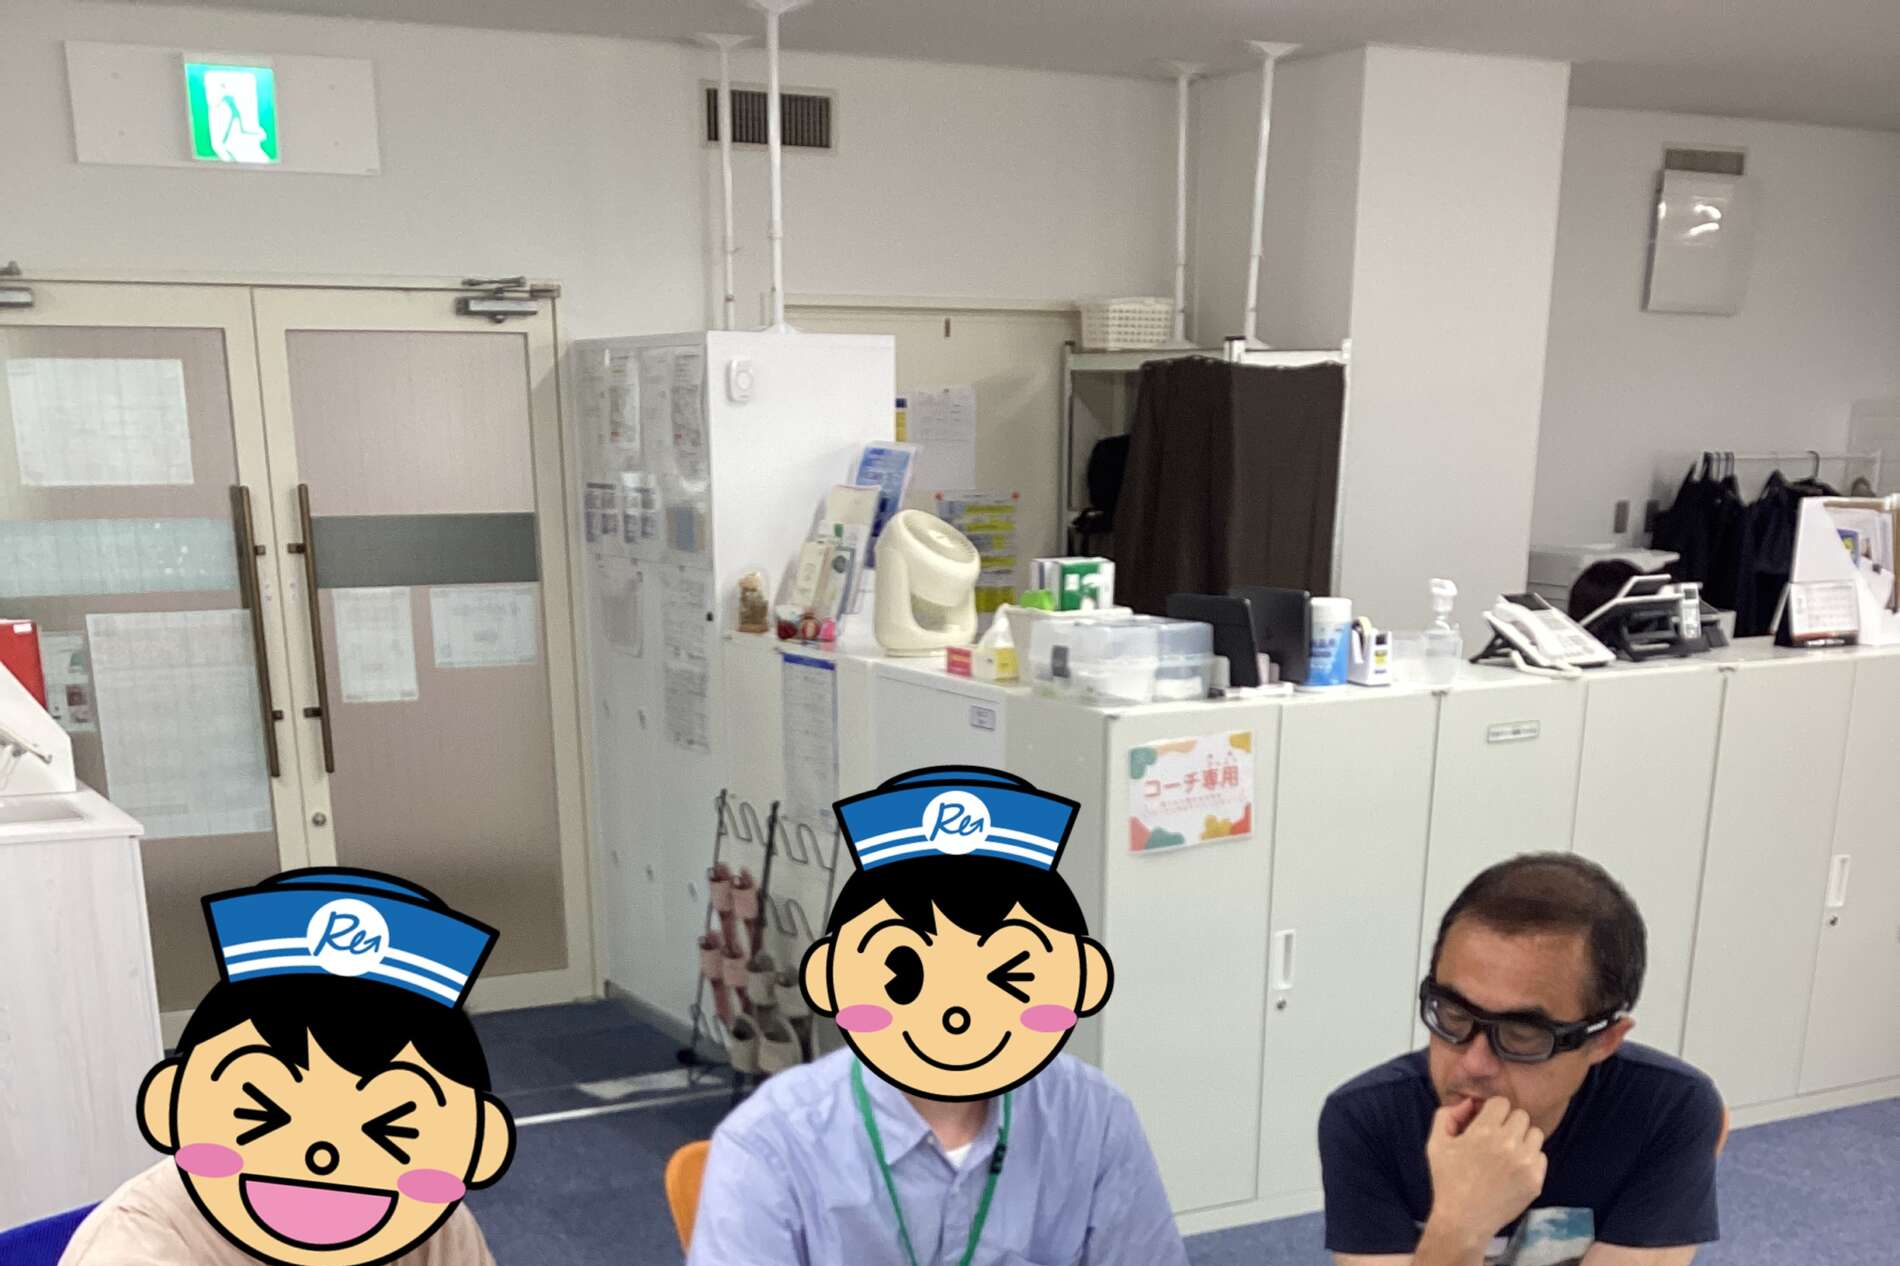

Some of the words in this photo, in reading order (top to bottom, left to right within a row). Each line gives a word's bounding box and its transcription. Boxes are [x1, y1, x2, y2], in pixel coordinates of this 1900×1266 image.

[1143, 765, 1239, 798] コーチ専用
